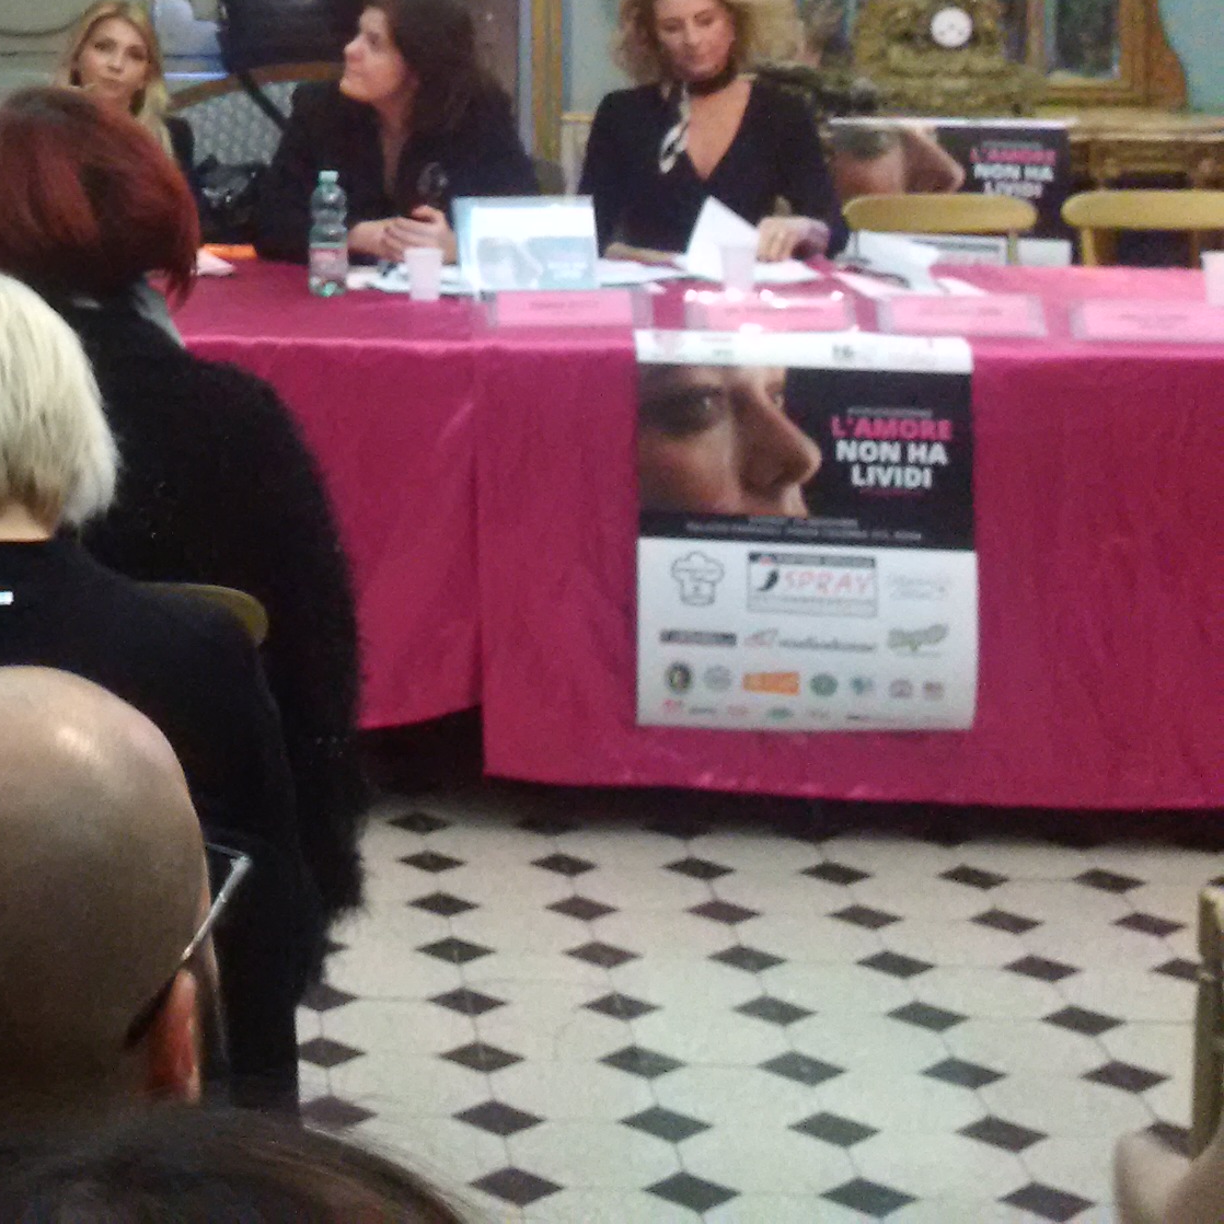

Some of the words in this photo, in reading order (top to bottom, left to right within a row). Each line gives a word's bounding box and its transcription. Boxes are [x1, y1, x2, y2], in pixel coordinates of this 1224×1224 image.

[831, 415, 953, 441] L'AMORE
[836, 439, 902, 464] NON
[906, 441, 949, 466] HA
[851, 463, 934, 489] LIVIDI
